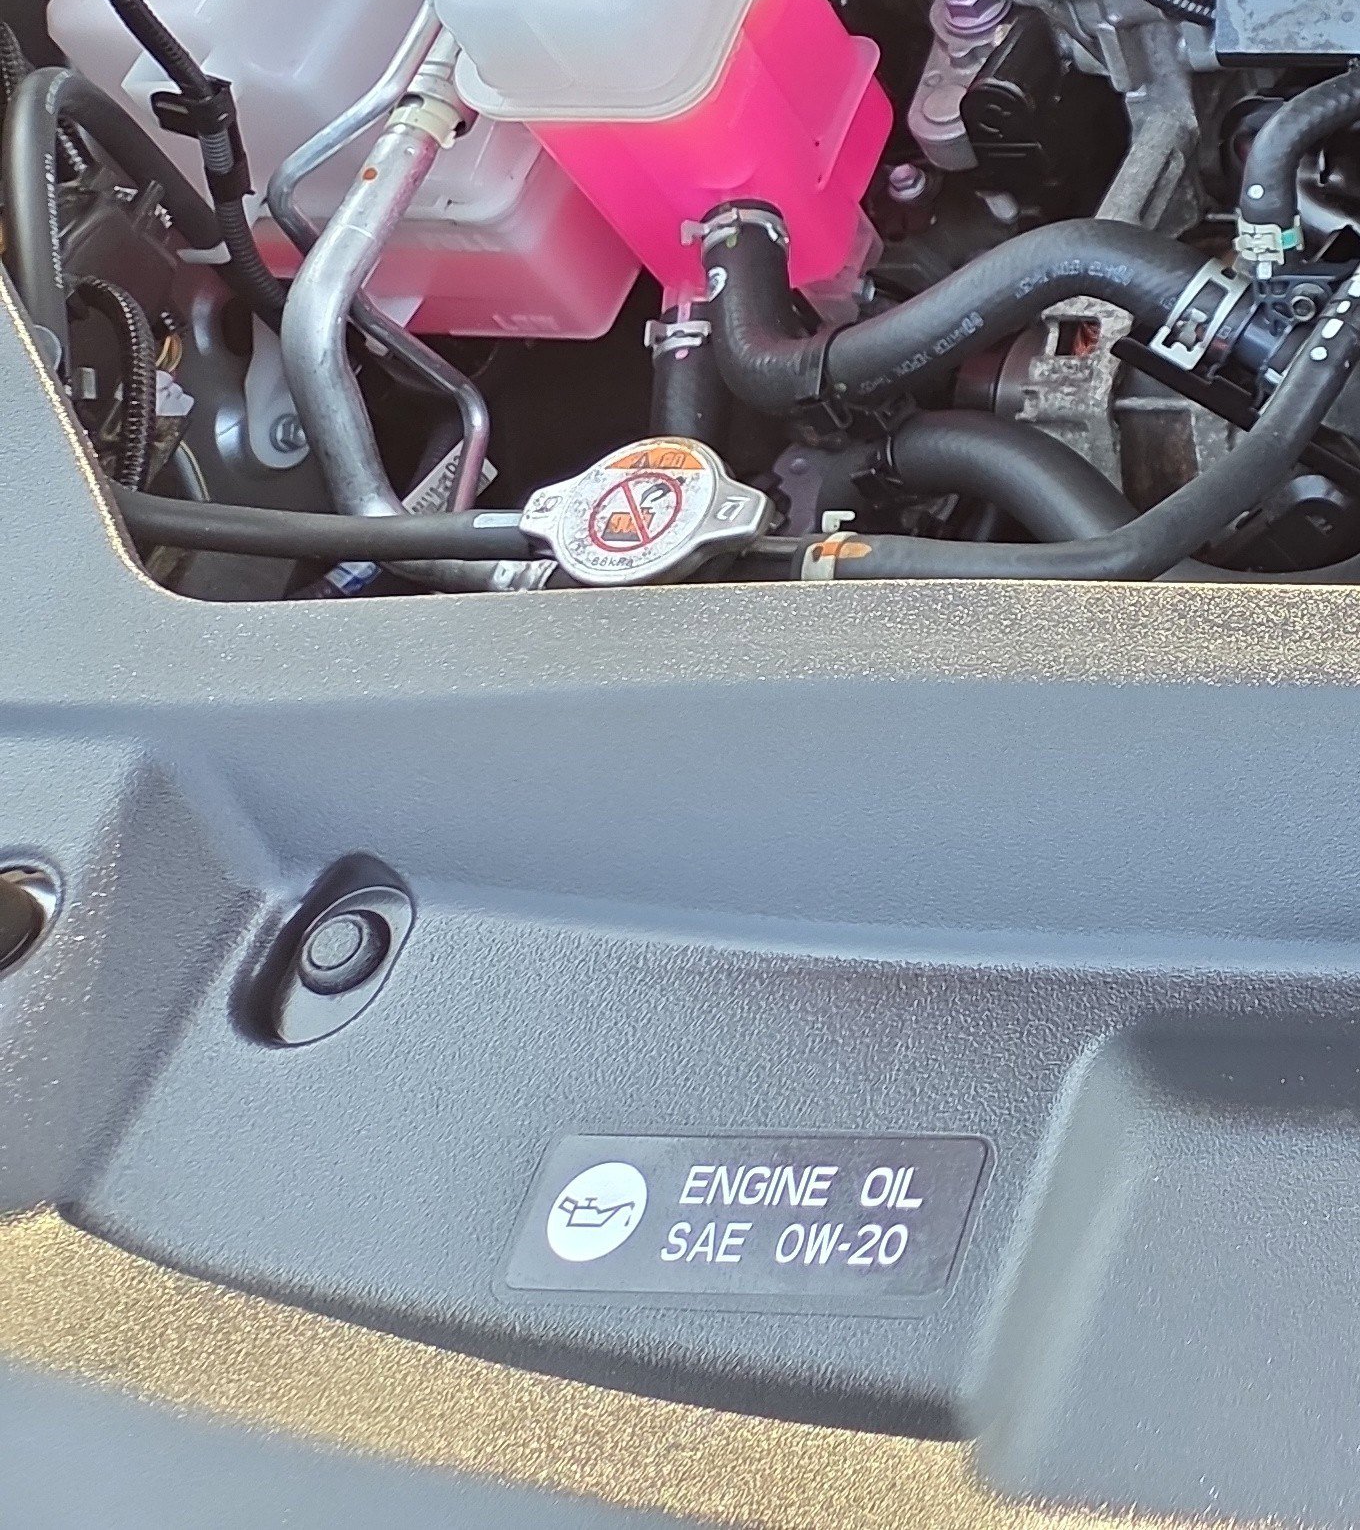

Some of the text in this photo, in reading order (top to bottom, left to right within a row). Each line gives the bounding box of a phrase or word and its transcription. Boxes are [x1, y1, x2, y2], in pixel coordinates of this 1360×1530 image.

[679, 1165, 924, 1209] ENGINE OIL
[660, 1223, 910, 1266] SAE 0W-20
